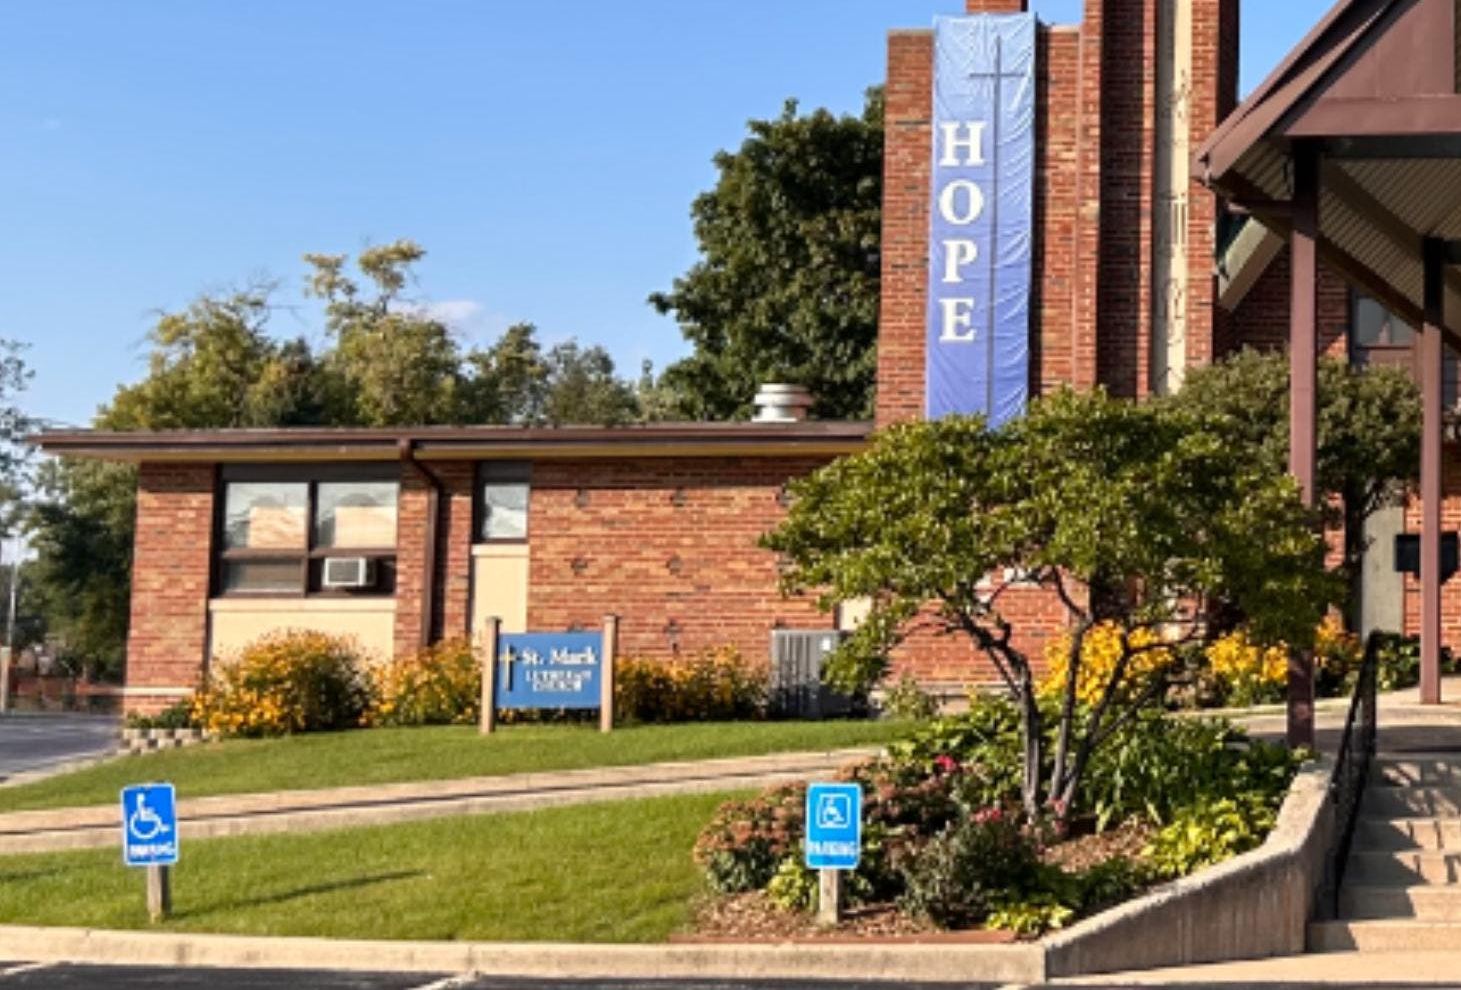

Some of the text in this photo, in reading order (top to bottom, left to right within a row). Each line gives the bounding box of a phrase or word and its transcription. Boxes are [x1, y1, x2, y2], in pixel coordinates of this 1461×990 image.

[938, 120, 987, 344] HOPE
[521, 646, 597, 665] St. Mark
